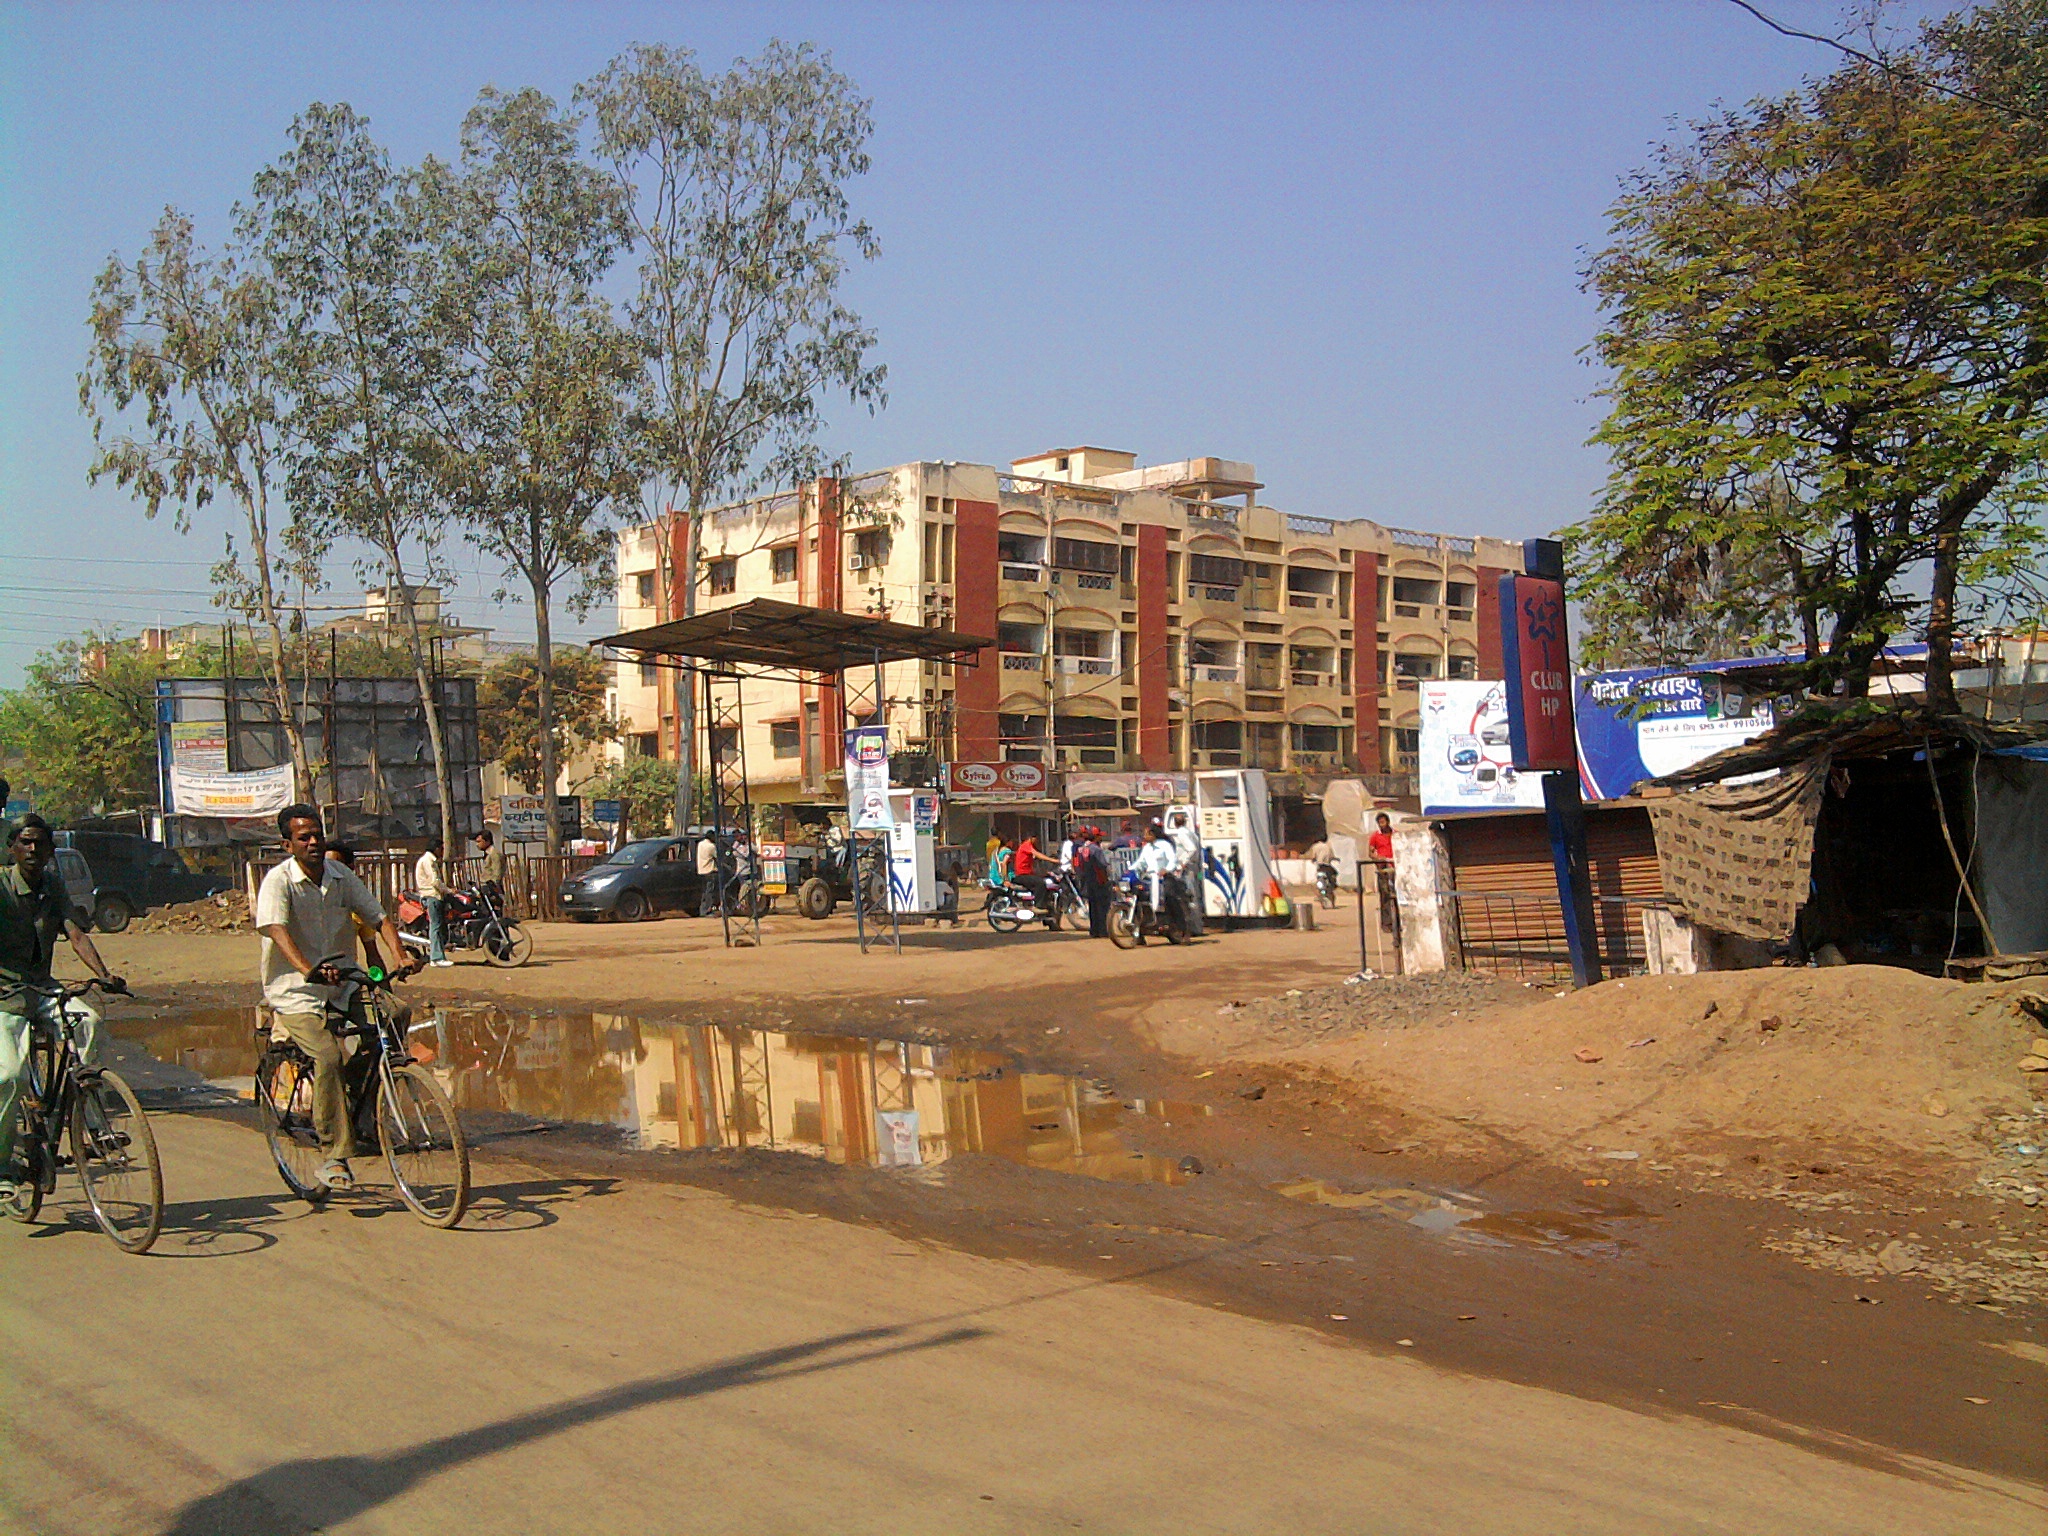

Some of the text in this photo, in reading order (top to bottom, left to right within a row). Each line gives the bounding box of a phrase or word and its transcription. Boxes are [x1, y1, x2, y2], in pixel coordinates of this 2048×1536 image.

[1531, 671, 1563, 690] CLUB
[1541, 697, 1559, 716] HP
[963, 769, 991, 781] Sylvan
[1009, 768, 1036, 781] Sylvan
